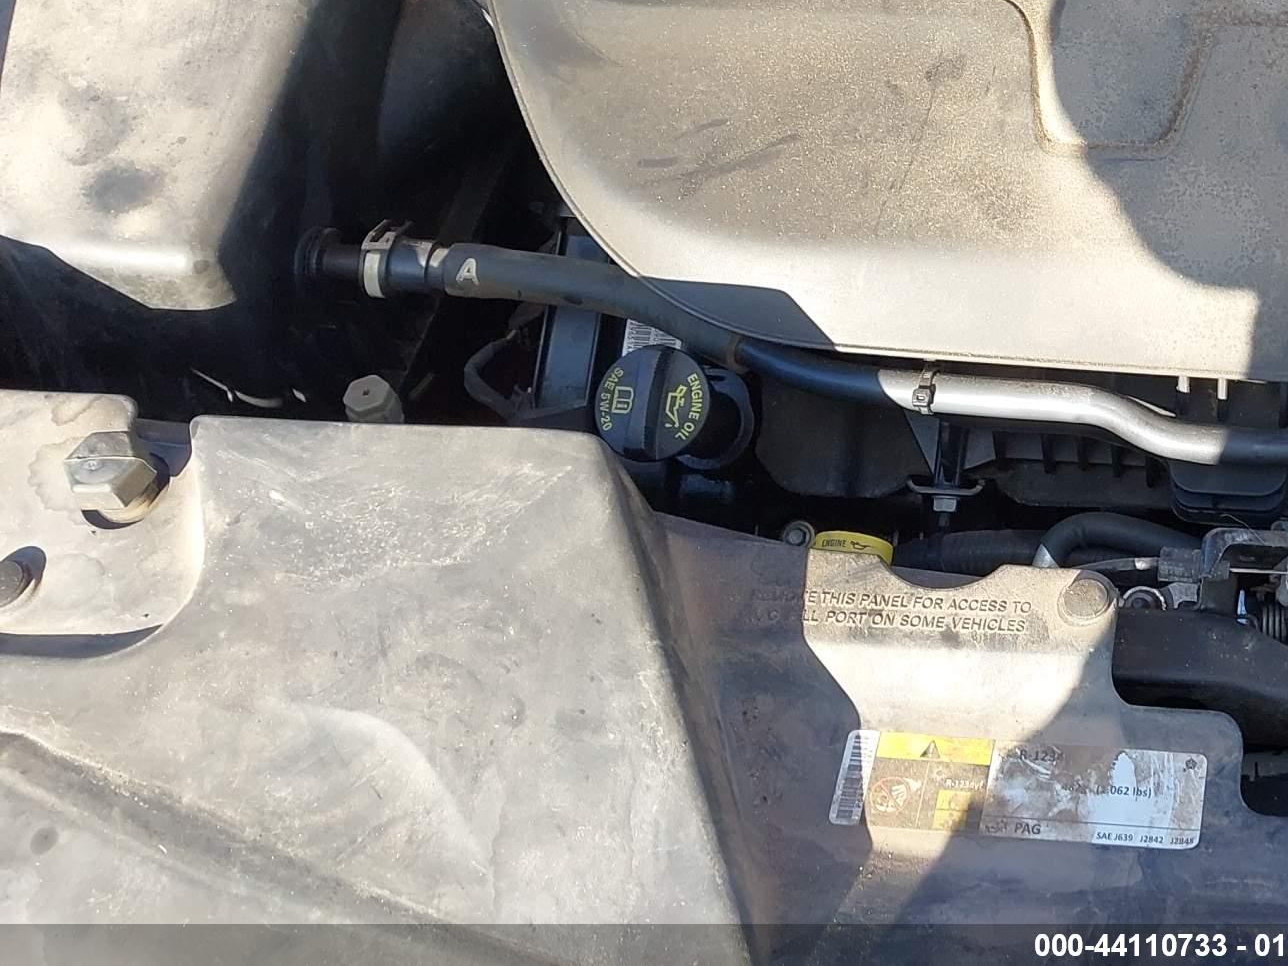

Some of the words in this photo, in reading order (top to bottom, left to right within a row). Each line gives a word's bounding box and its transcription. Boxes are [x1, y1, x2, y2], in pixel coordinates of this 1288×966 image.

[455, 257, 480, 285] A
[604, 367, 624, 390] SAE
[686, 373, 703, 421] ENGINE
[599, 392, 613, 431] 5W-20
[674, 422, 695, 441] OIL
[821, 538, 846, 548] ENGINE
[821, 591, 856, 605] THIS
[859, 593, 908, 609] PANEL
[912, 596, 944, 610] FOR
[946, 598, 1008, 612] ACCESS
[1012, 600, 1032, 613] TO
[825, 610, 868, 625] PORT
[871, 613, 896, 626] ON
[900, 614, 946, 628] SOME
[951, 616, 1026, 632] VEHICLES
[1132, 786, 1152, 799] lbs)
[1013, 822, 1041, 835] PAG
[1114, 833, 1134, 842] J639
